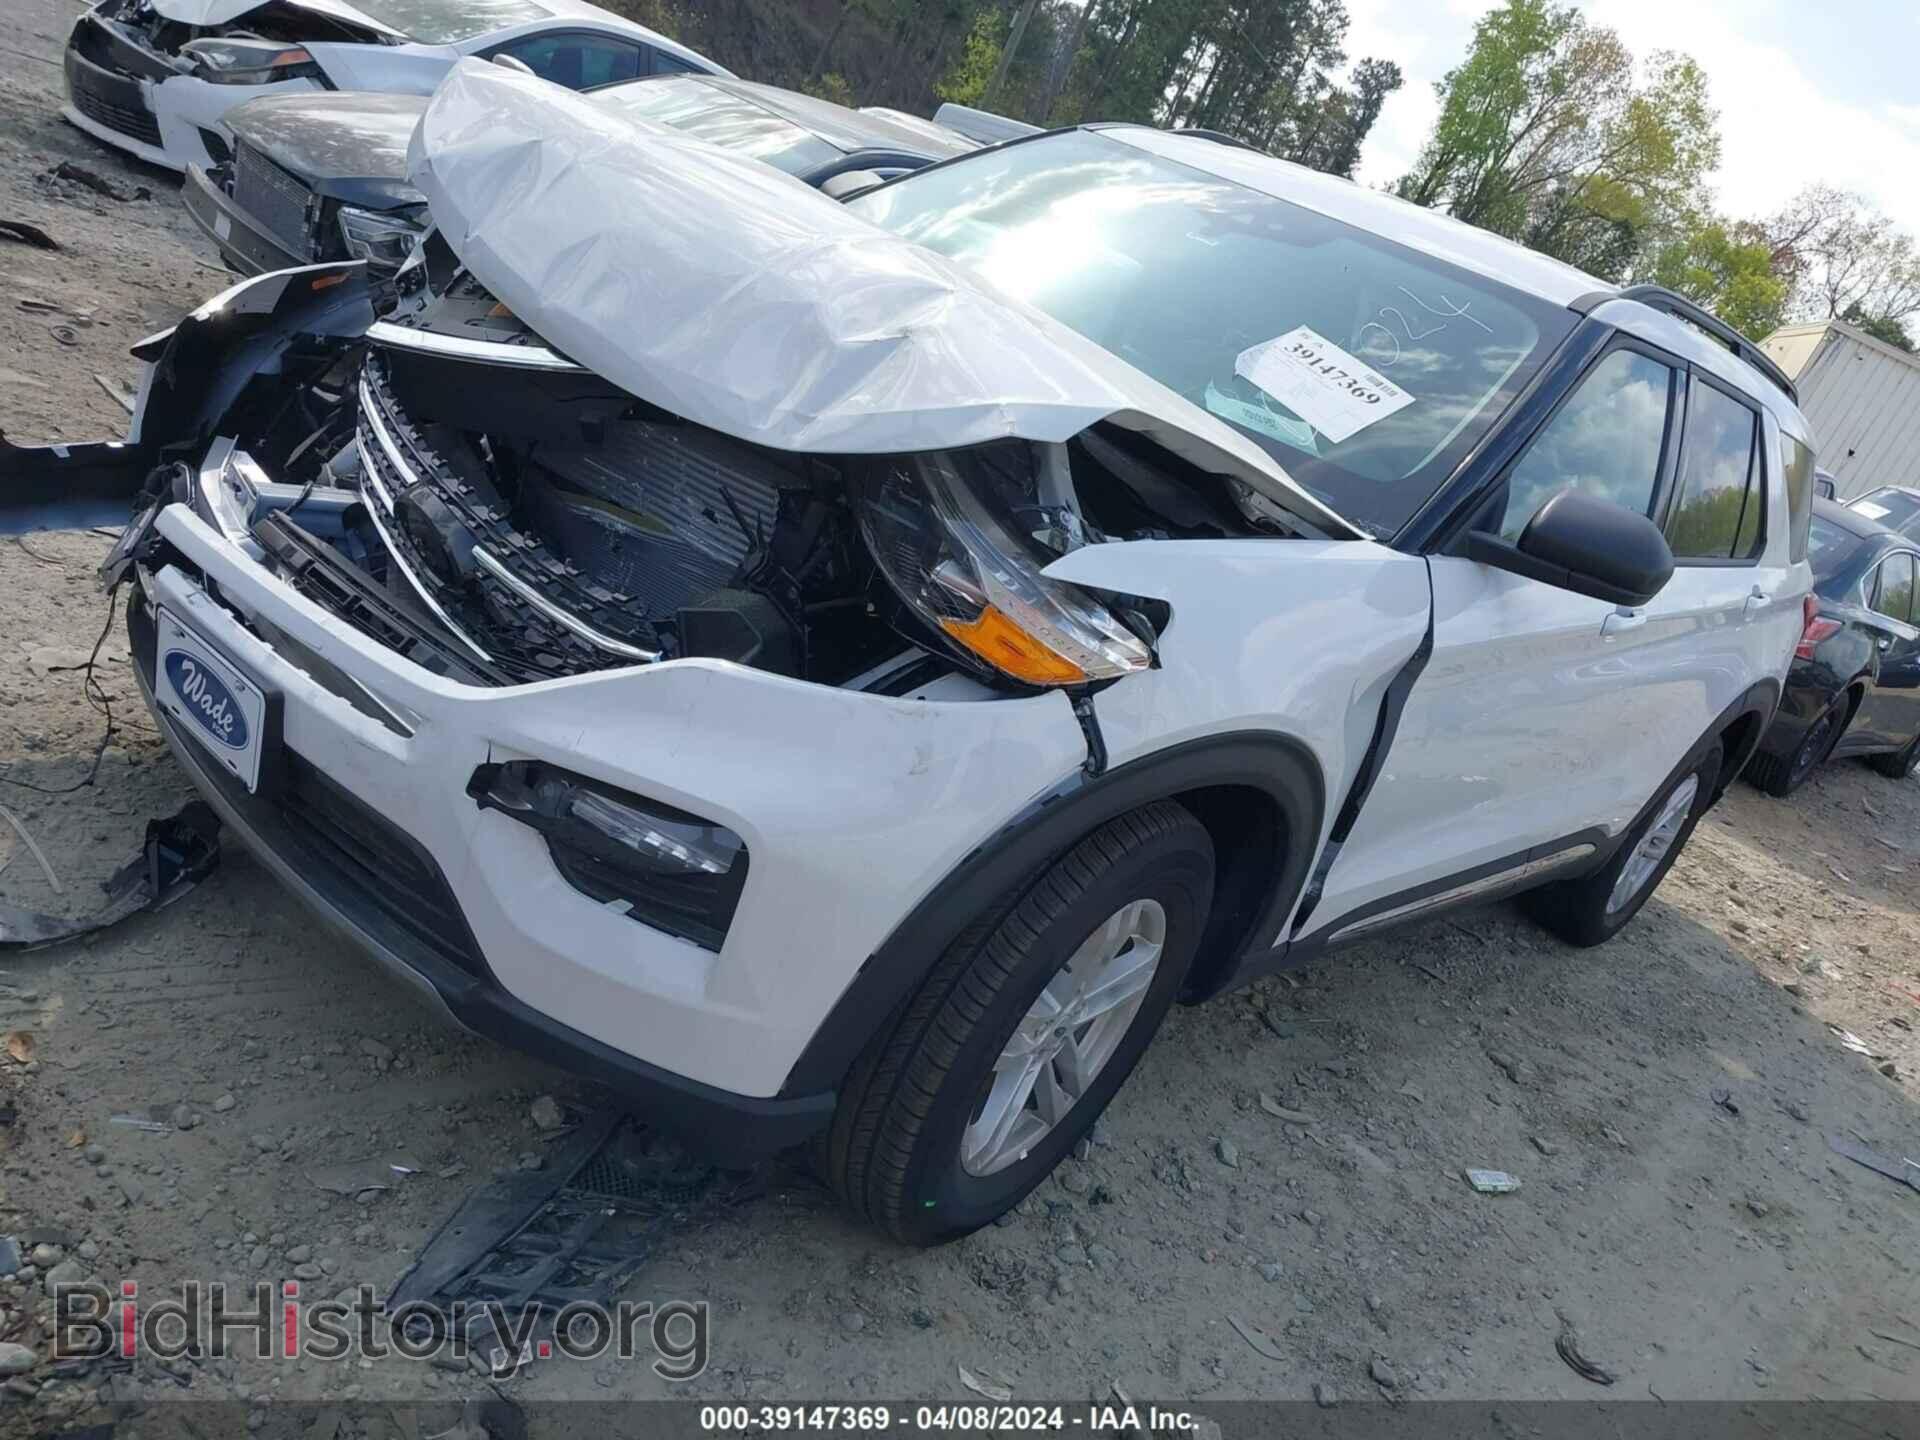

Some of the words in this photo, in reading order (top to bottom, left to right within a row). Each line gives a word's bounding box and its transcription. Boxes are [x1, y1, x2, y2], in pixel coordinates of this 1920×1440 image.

[1336, 286, 1493, 366] 024
[1284, 343, 1381, 404] 39147369
[181, 658, 233, 733] Wade
